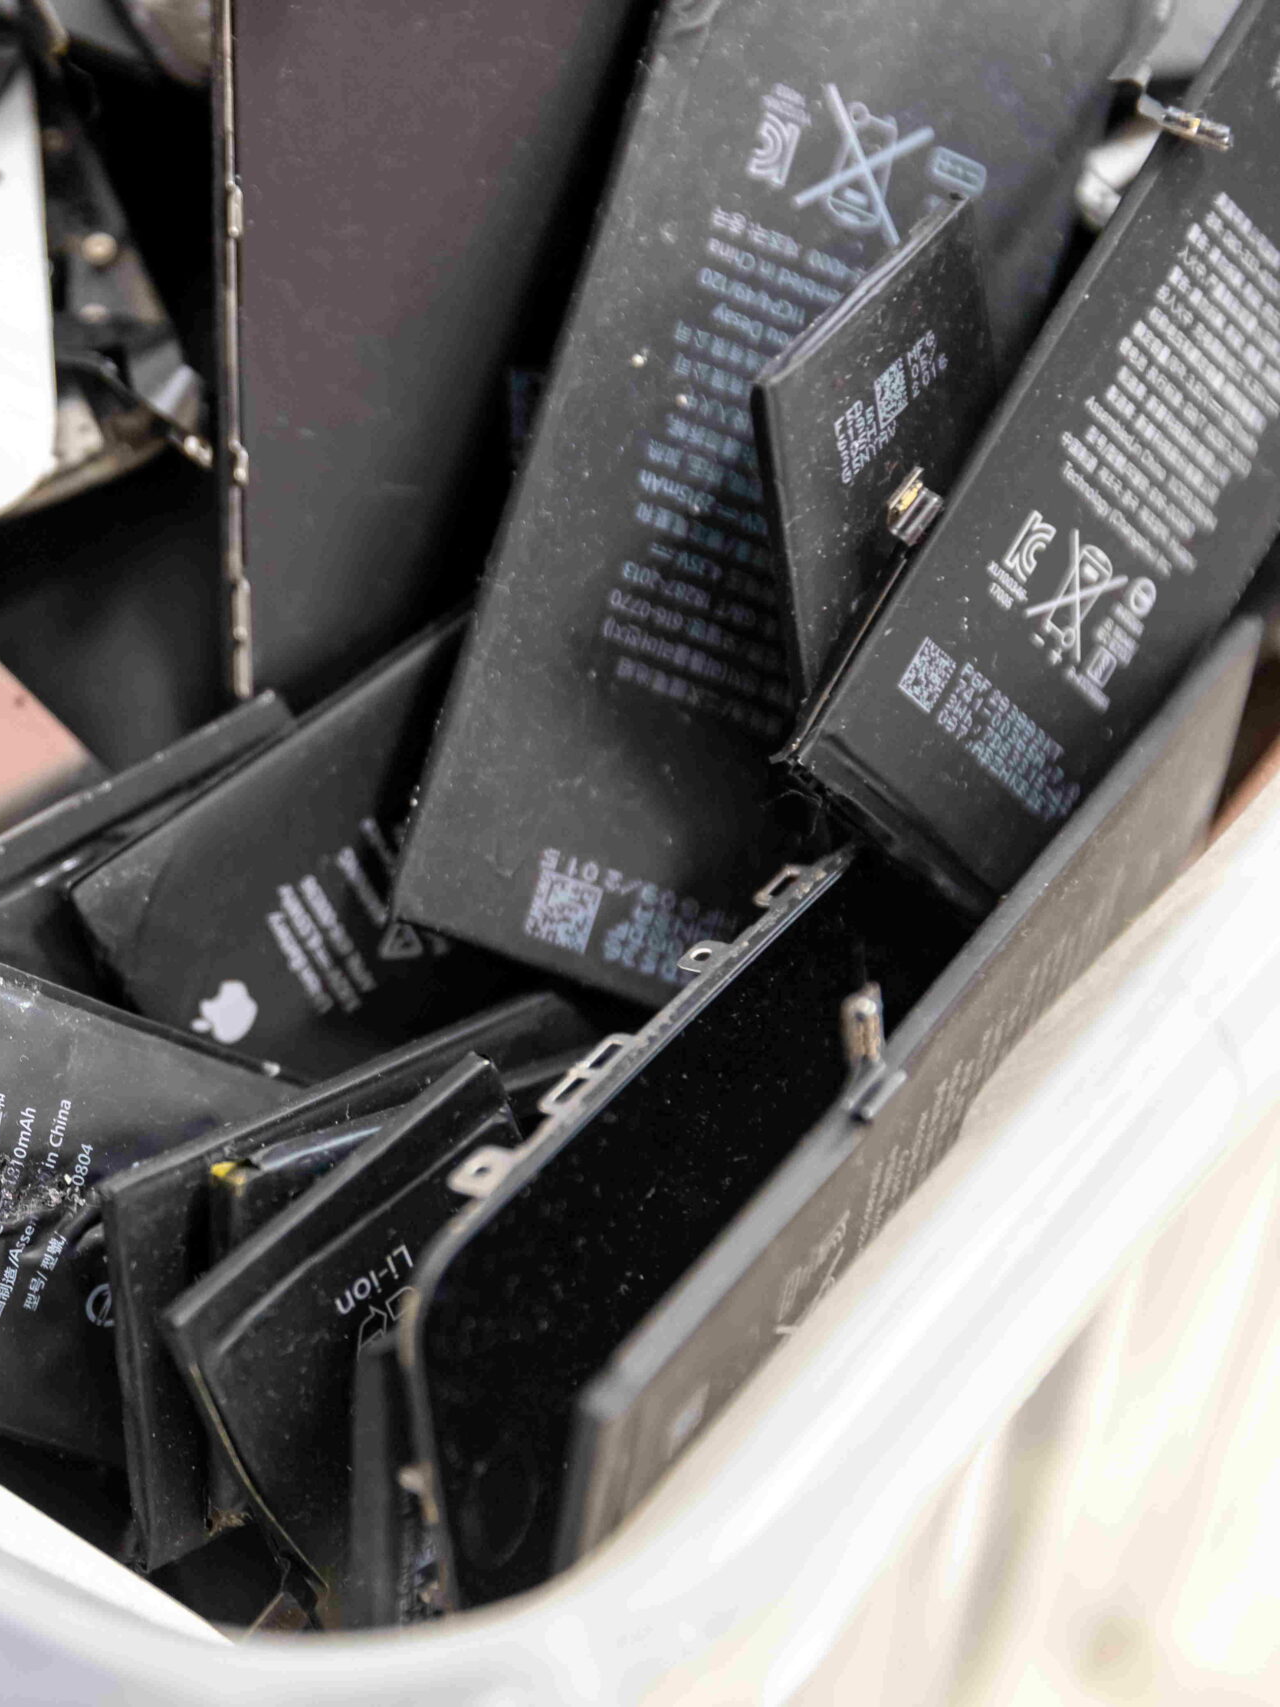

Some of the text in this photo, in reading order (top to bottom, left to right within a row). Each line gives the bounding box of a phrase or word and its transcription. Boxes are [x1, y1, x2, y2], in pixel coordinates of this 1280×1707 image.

[46, 1097, 73, 1149] China
[40, 1148, 59, 1170] in
[334, 1243, 414, 1315] Li-ion
